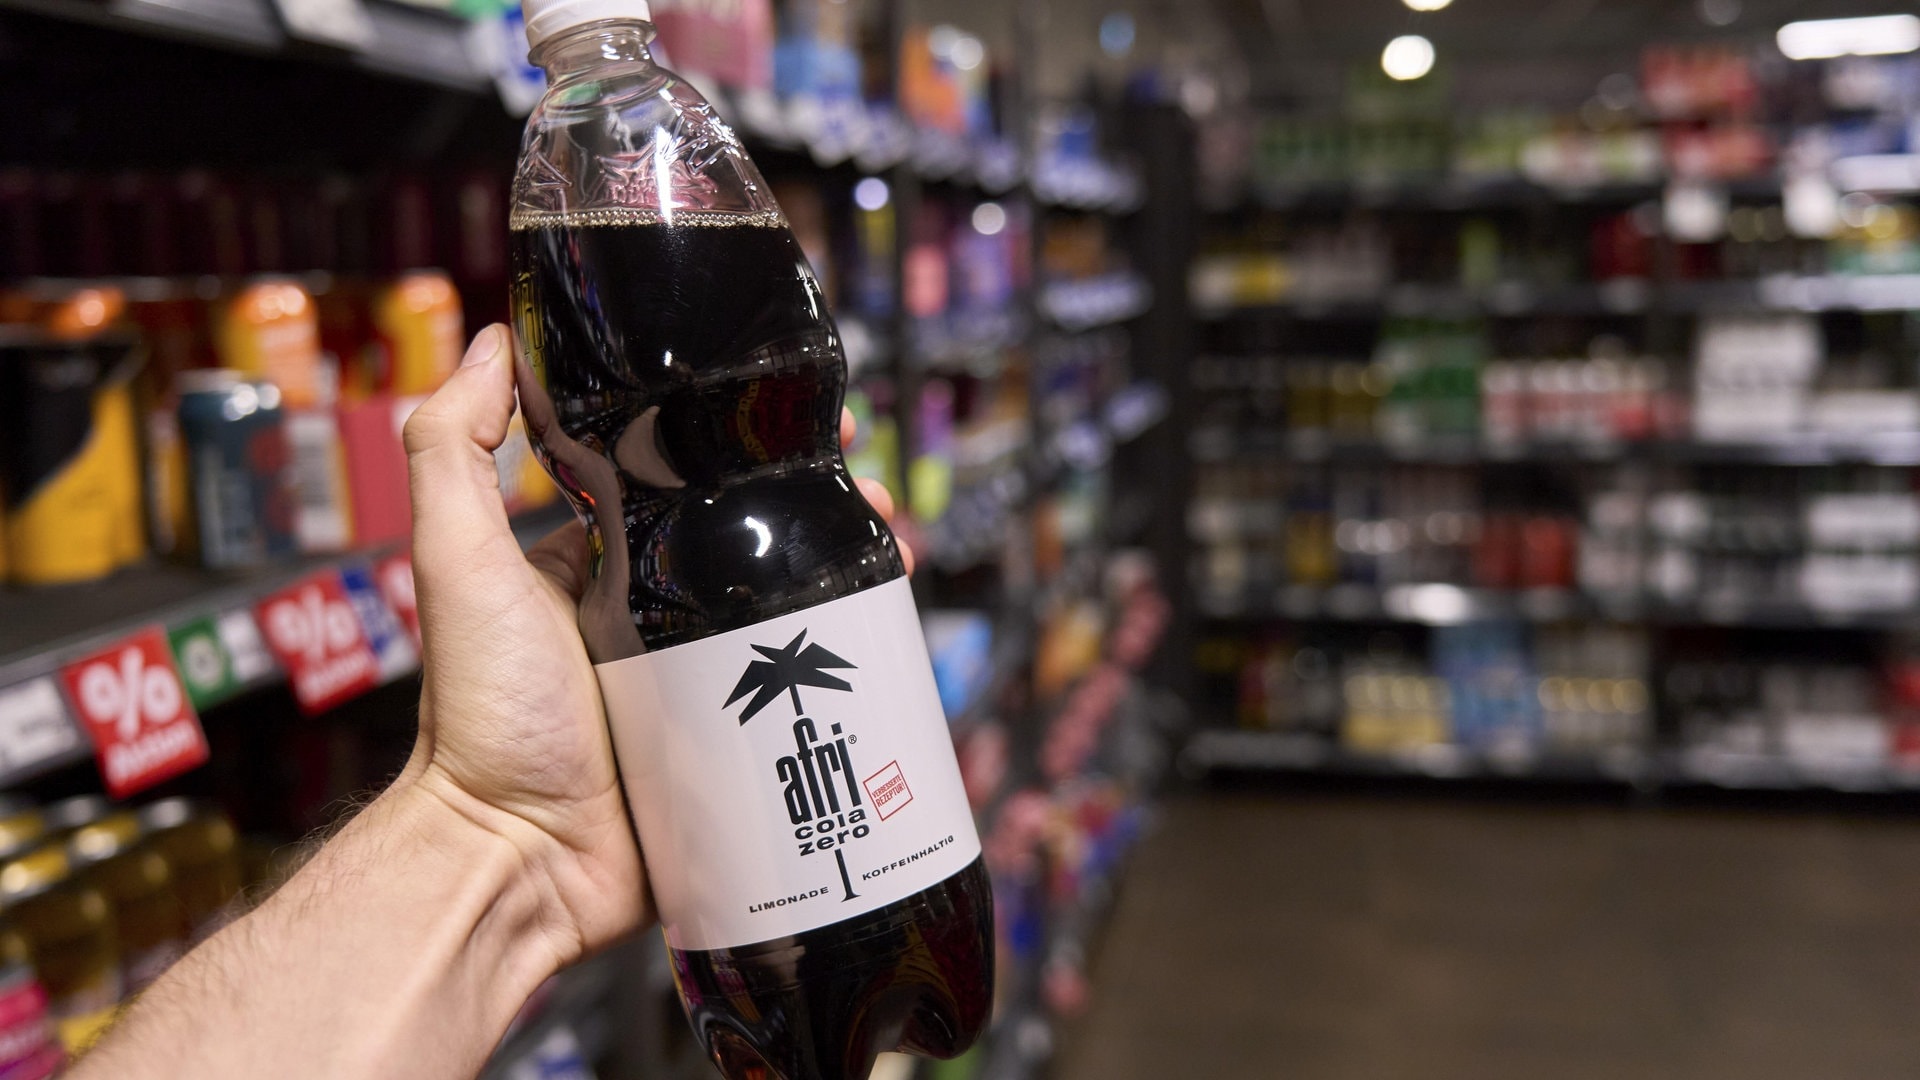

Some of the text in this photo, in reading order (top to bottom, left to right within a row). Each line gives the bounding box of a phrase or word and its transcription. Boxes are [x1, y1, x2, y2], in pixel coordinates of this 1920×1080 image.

[80, 646, 182, 740] %
[872, 774, 902, 798] VERBESSERTE
[875, 781, 905, 807] REZEPTUR!
[795, 808, 866, 840] cola
[799, 824, 870, 856] zero
[749, 835, 954, 913] LIMONADE KOFFEINHALTIG
